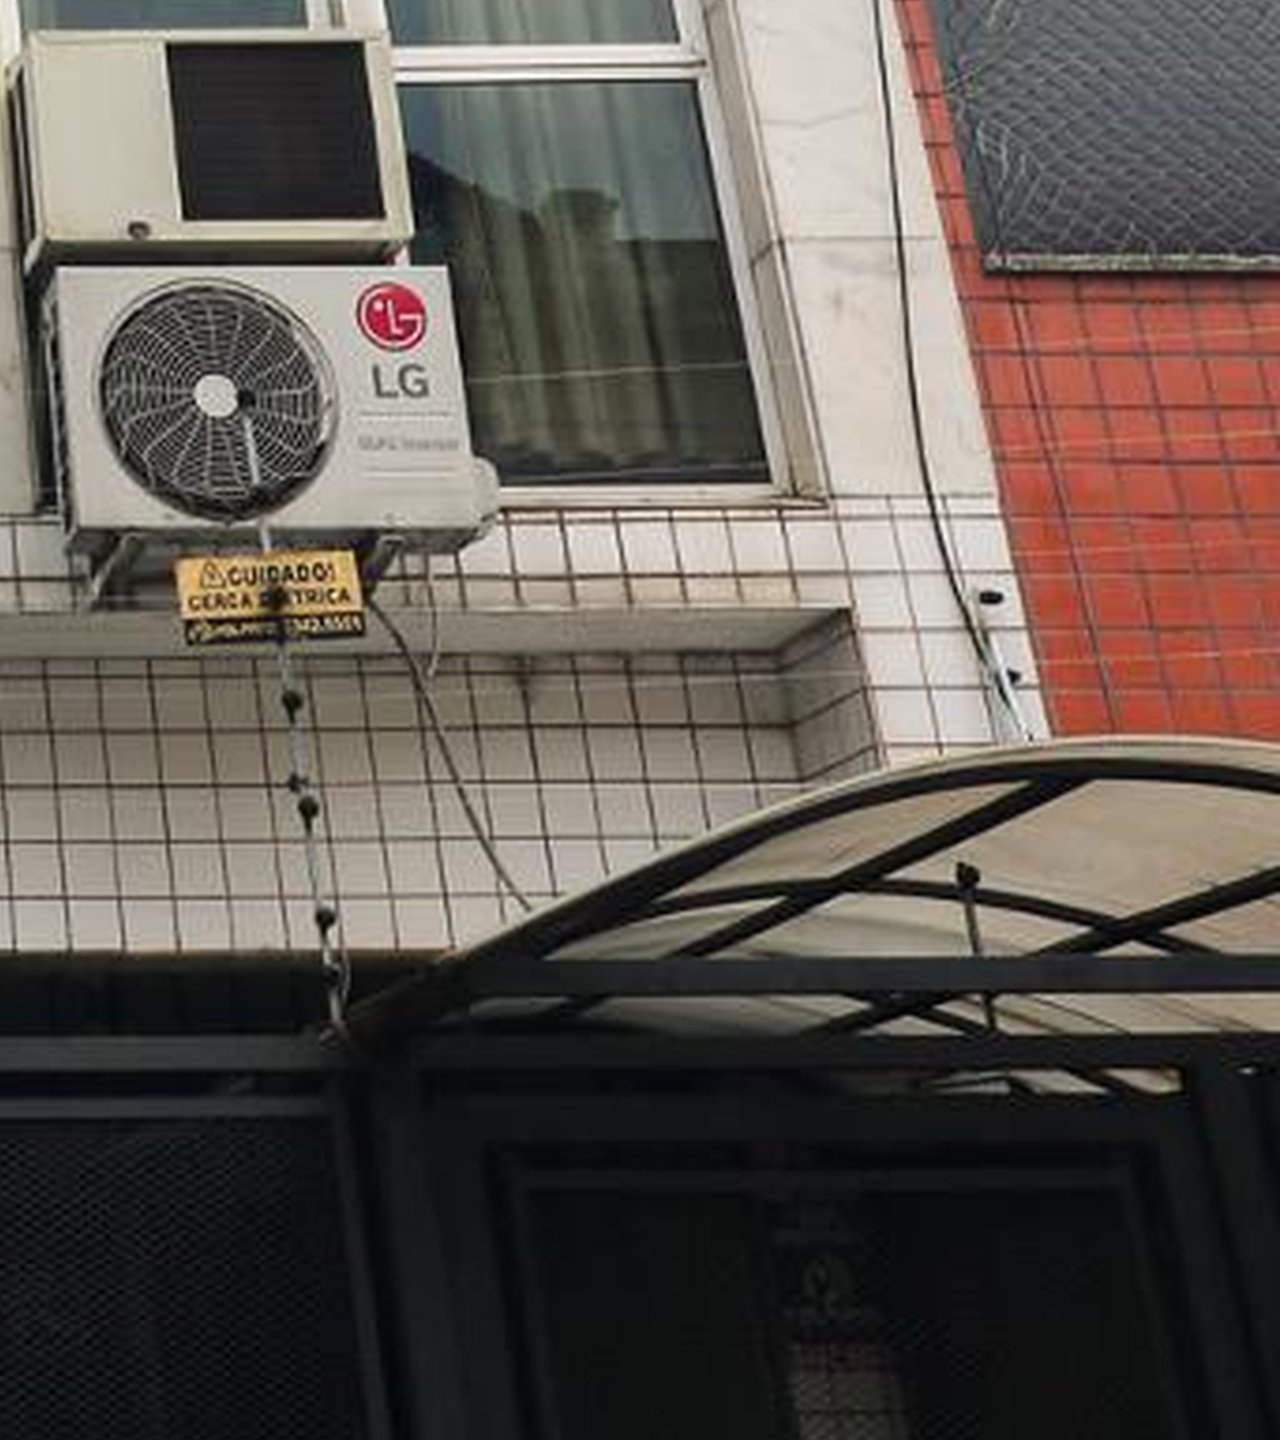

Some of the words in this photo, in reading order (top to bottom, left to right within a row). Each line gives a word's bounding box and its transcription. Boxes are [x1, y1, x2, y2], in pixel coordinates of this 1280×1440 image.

[372, 363, 430, 399] LG
[228, 563, 334, 586] CUIDADO!
[187, 592, 252, 611] CERCA
